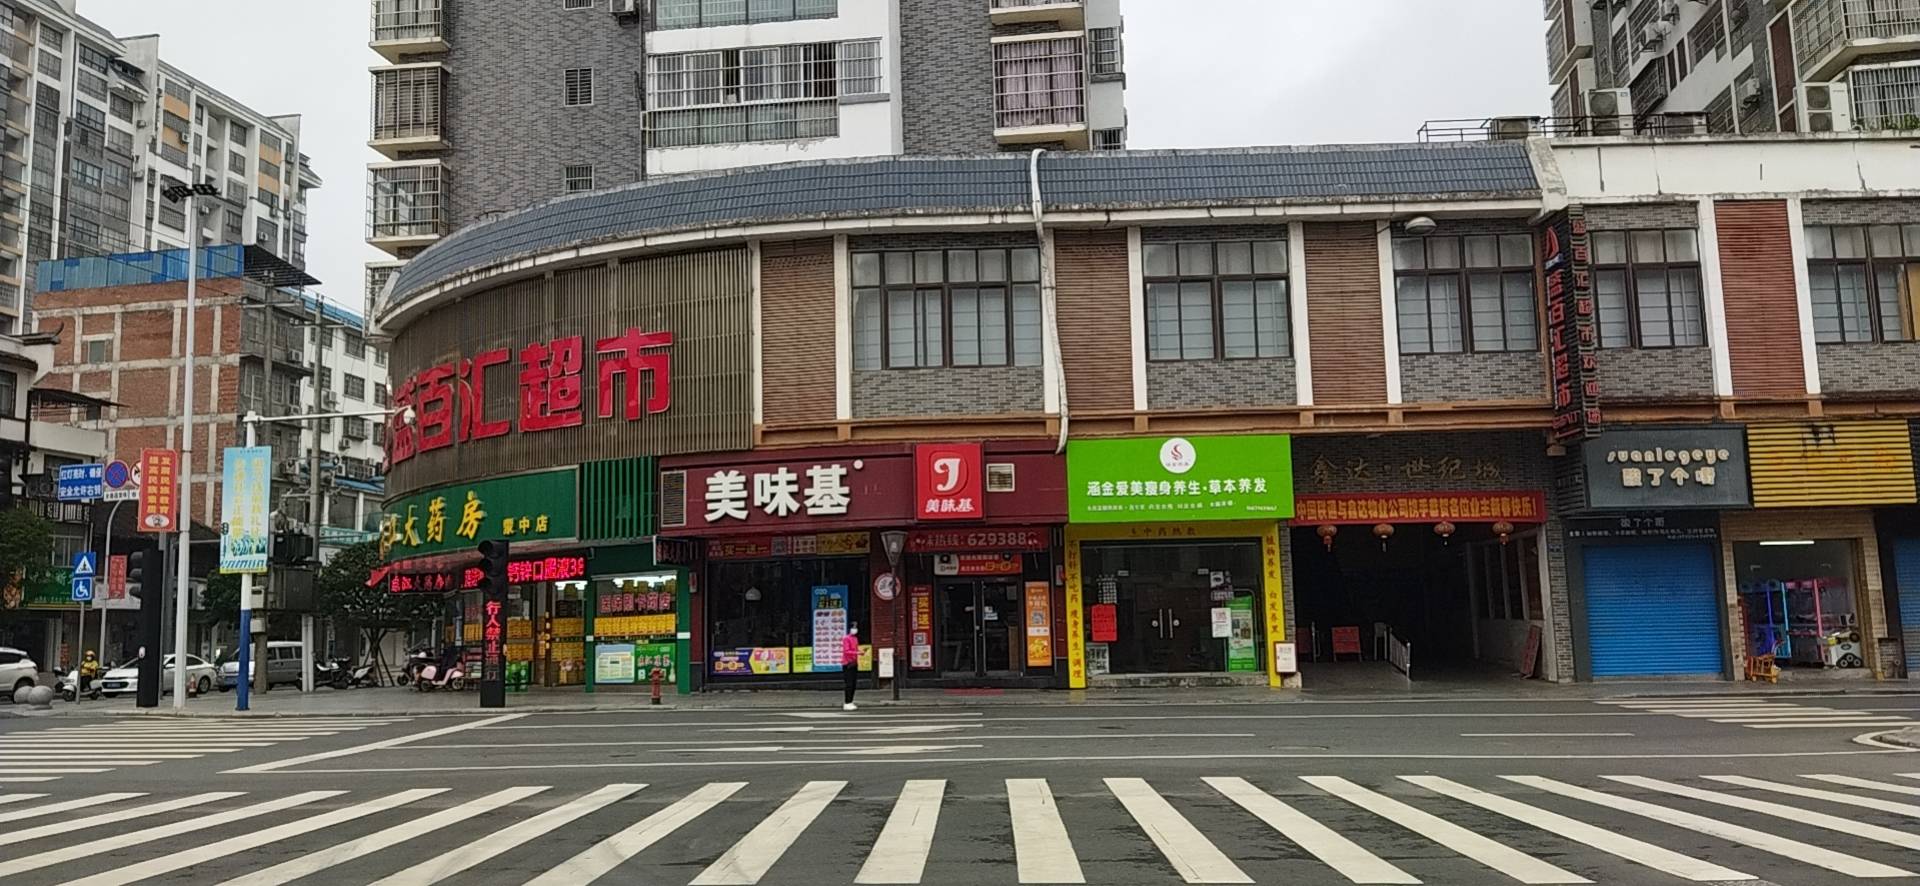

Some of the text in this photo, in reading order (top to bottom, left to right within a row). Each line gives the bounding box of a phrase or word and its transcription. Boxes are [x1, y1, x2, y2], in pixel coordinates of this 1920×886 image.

[705, 464, 850, 522] 美味基
[926, 498, 975, 513] 美味基
